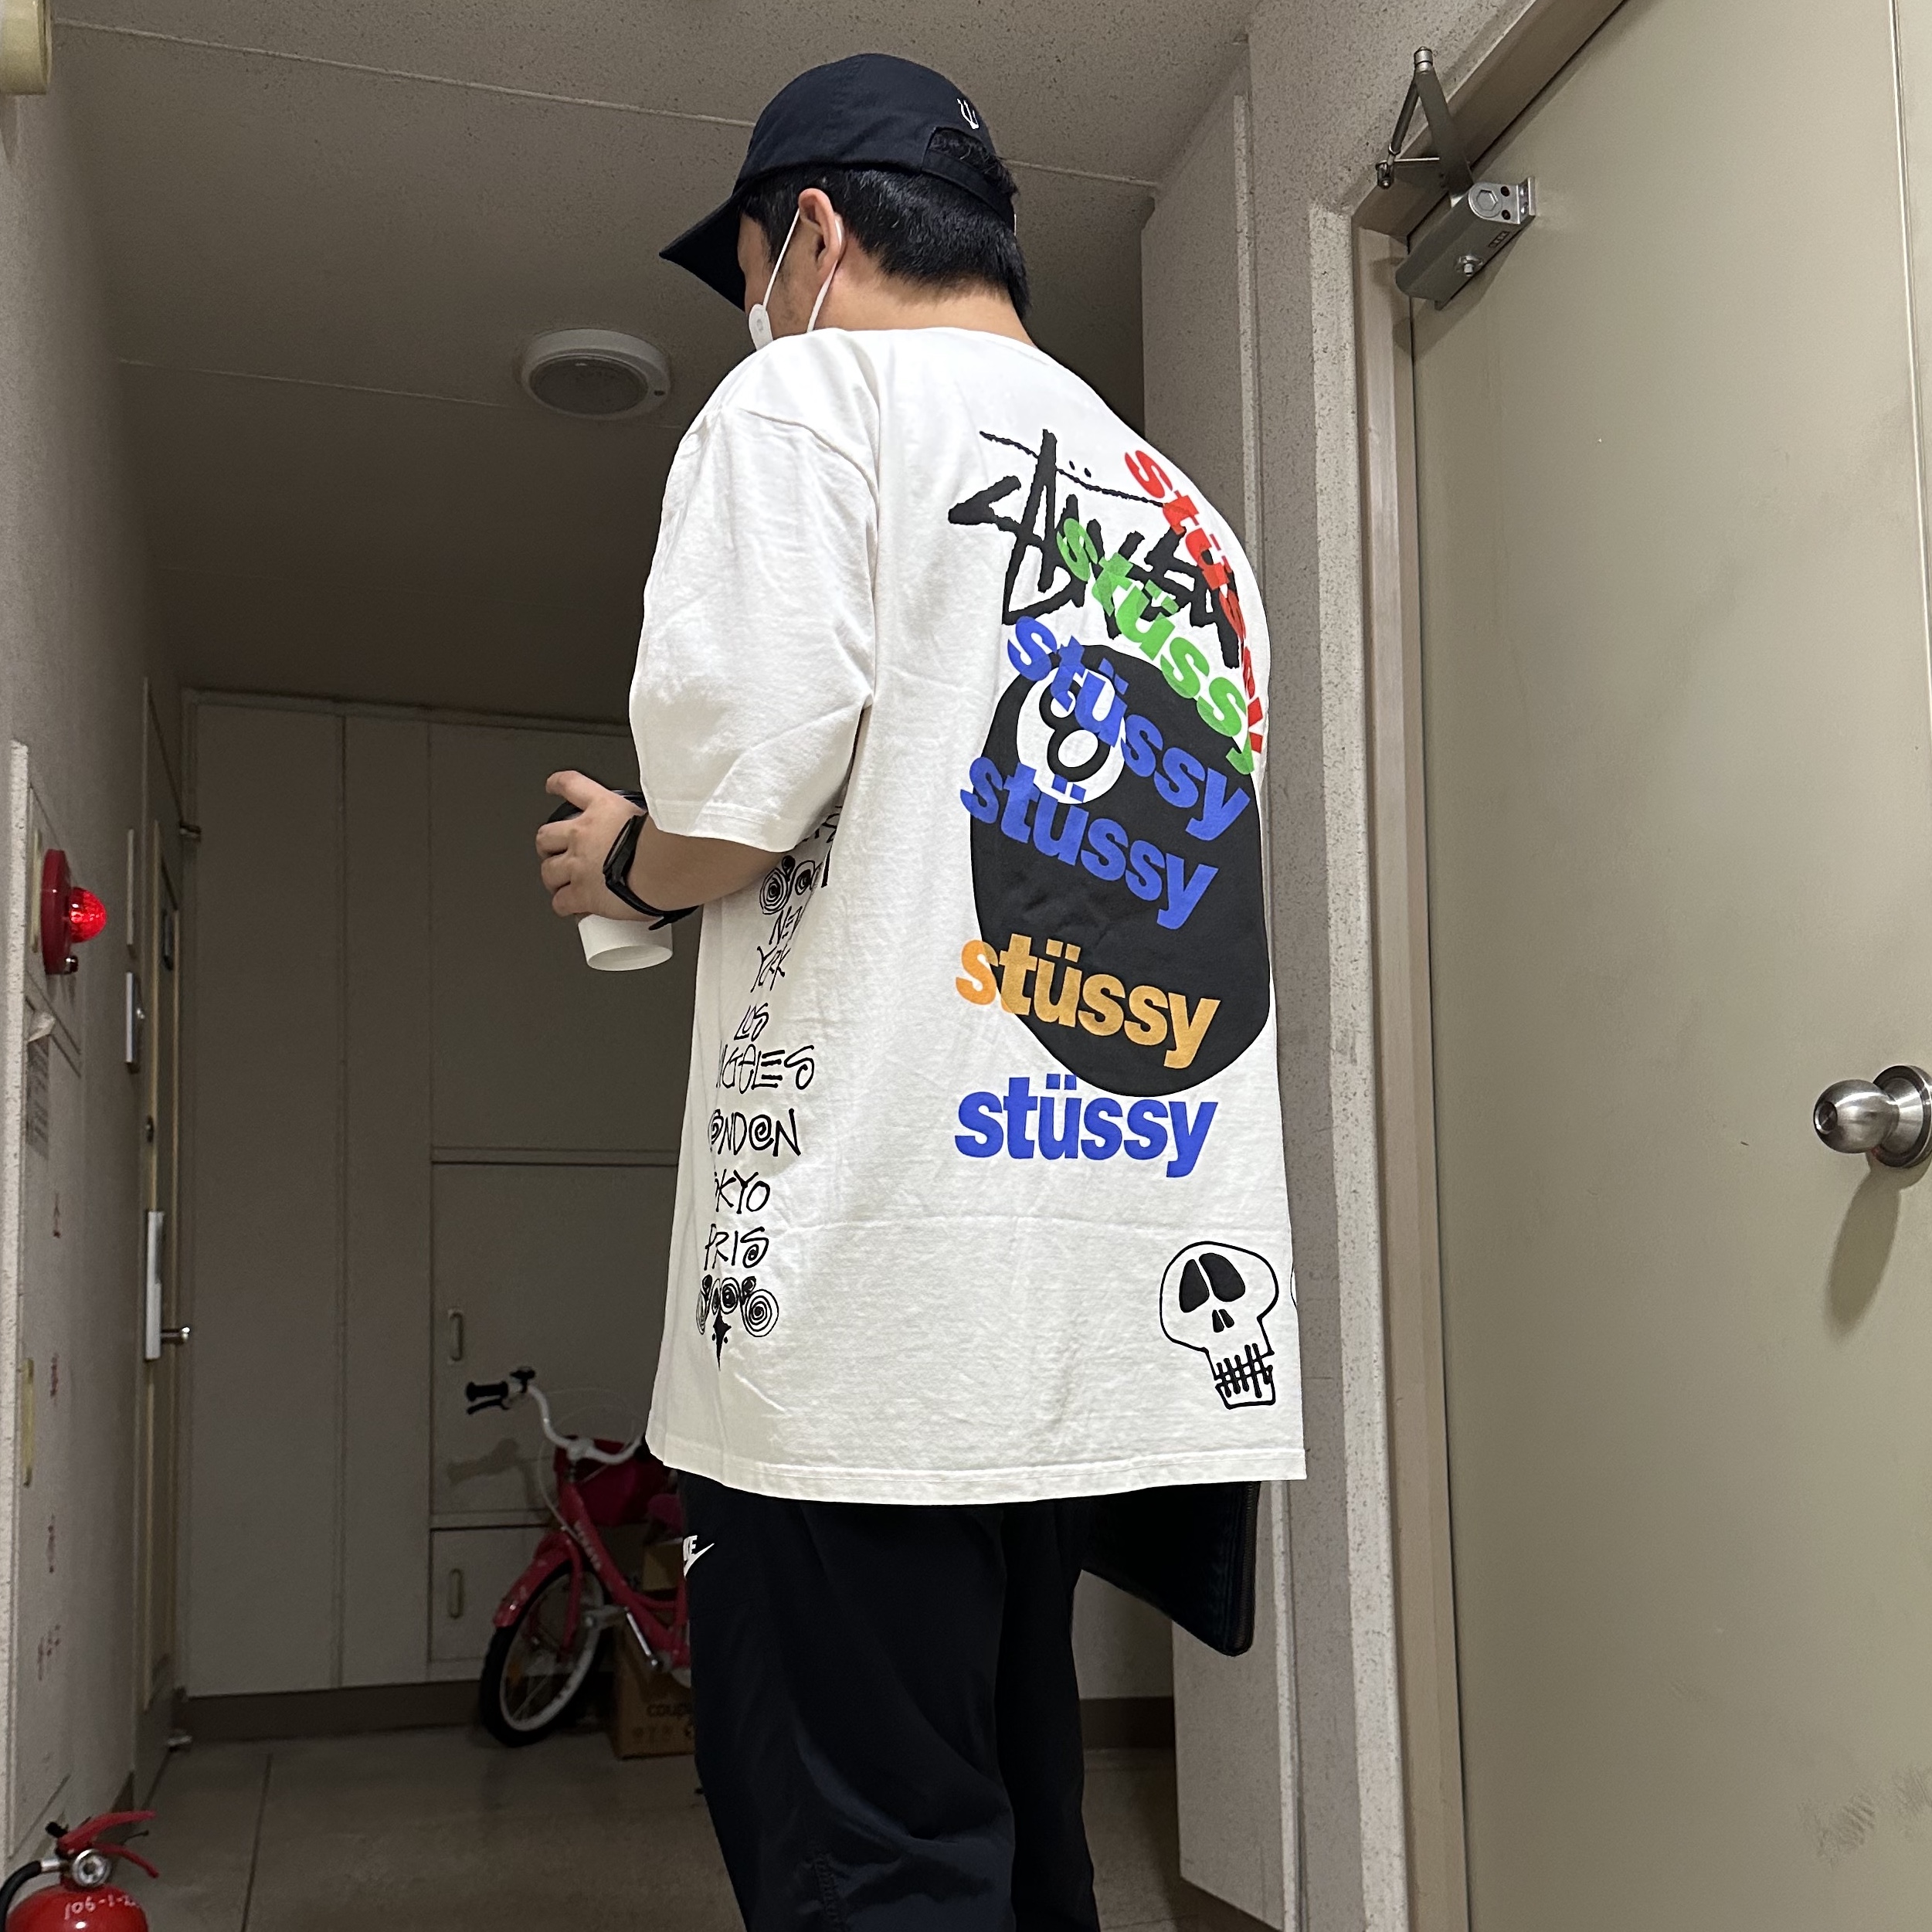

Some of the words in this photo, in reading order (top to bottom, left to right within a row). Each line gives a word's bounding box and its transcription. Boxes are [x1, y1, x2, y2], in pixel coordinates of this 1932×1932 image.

[1007, 616, 1251, 841] stüssy
[960, 756, 1219, 930] stüssy
[955, 934, 1221, 1070] stüssy
[708, 1108, 802, 1157] ONDON
[955, 1073, 1219, 1178] stüssy
